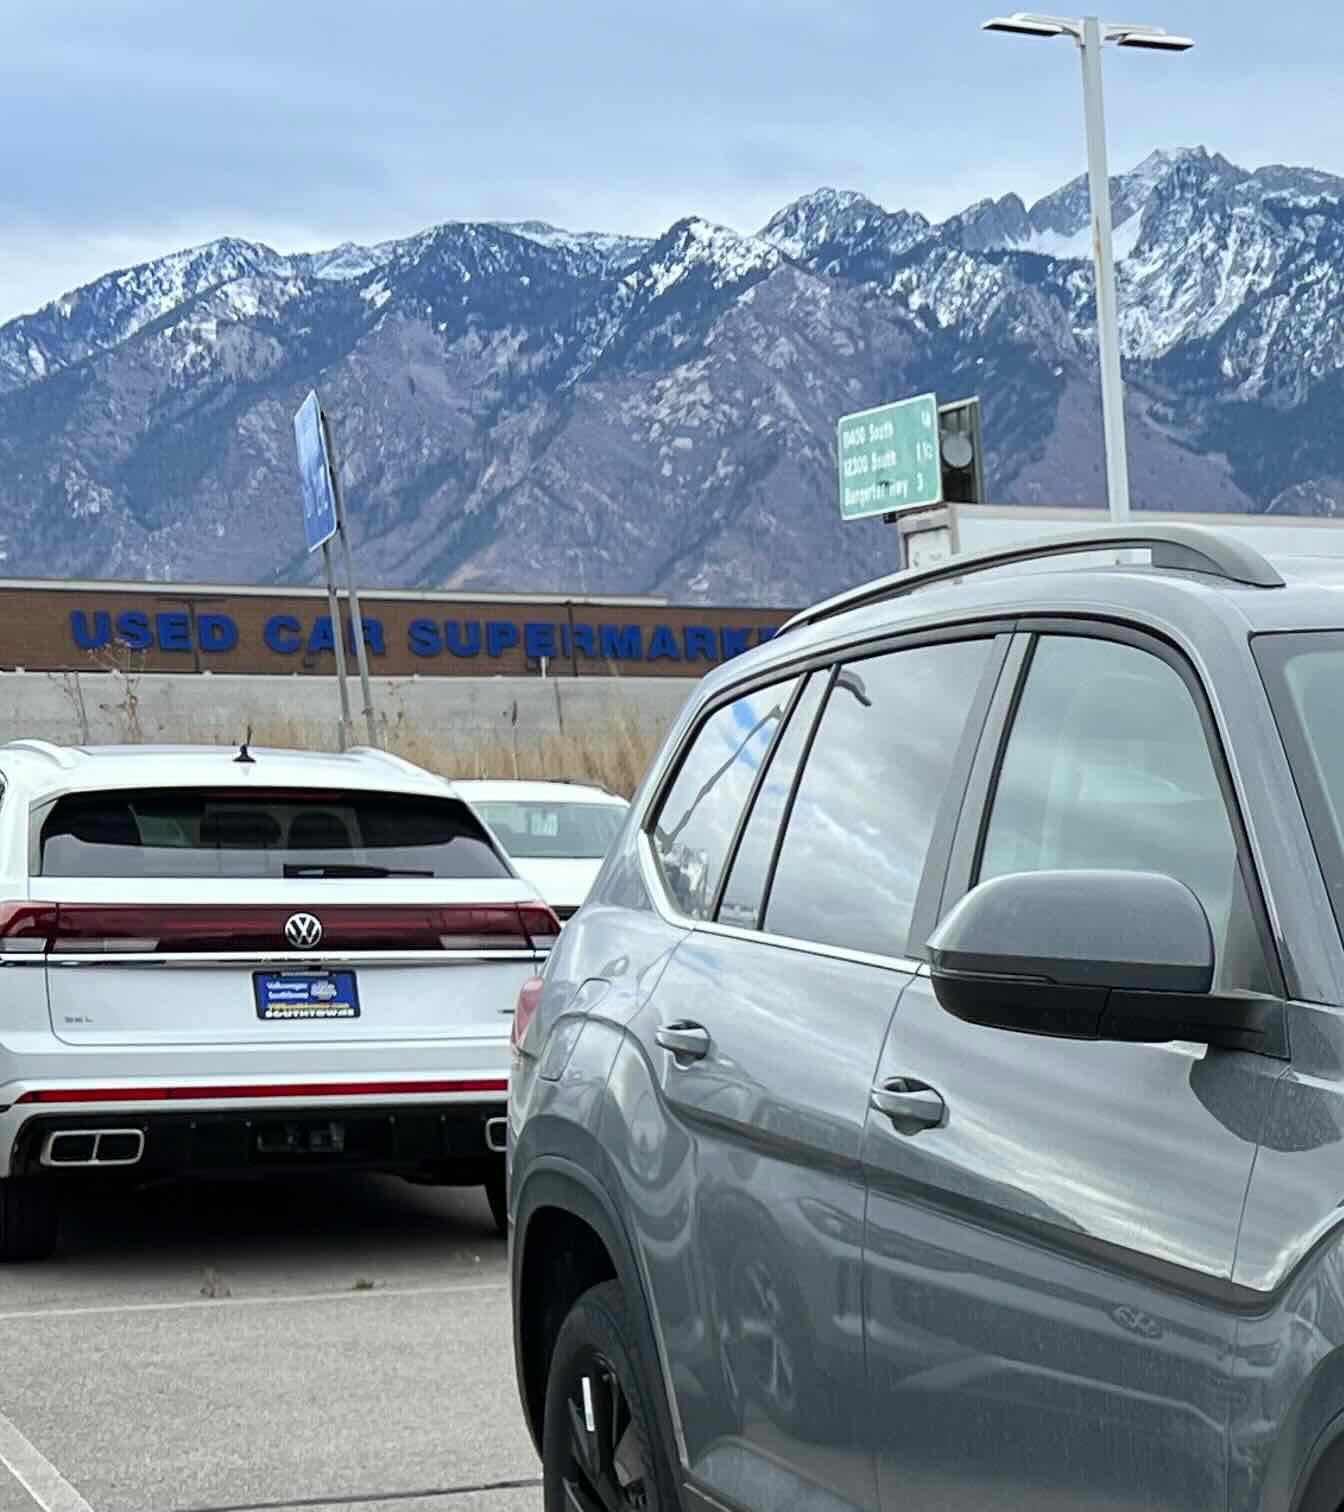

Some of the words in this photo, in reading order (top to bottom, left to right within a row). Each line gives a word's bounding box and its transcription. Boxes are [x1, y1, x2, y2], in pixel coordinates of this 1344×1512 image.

[69, 610, 240, 654] USED
[264, 615, 387, 656] CAR
[408, 618, 783, 659] SUPERMARK
